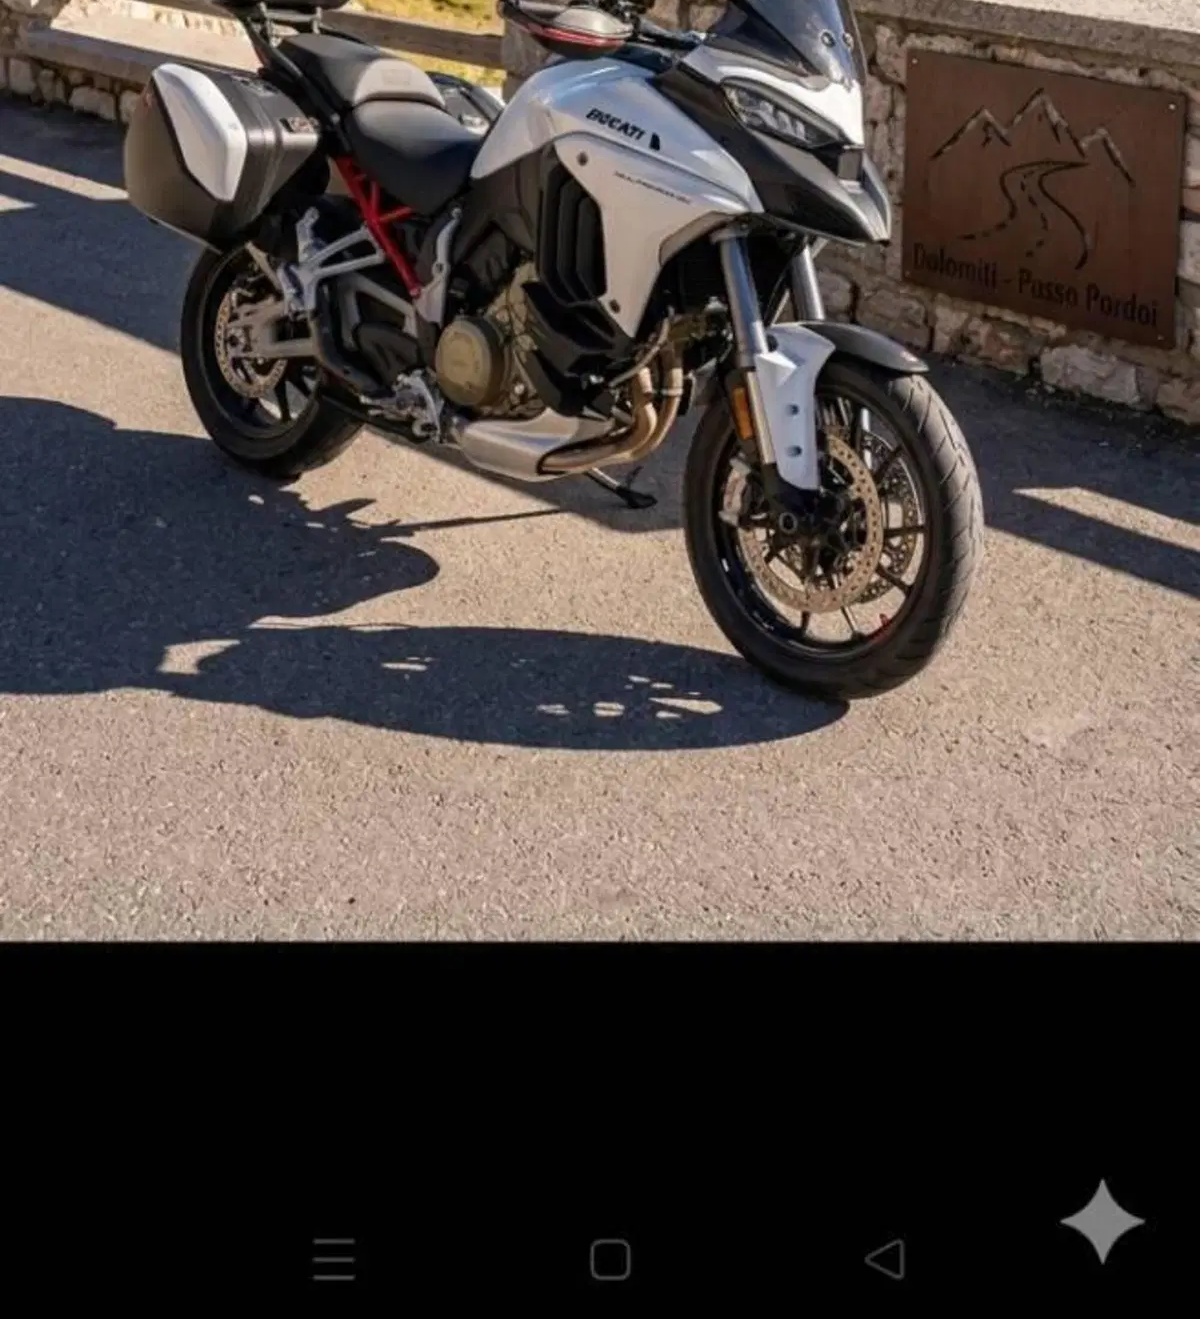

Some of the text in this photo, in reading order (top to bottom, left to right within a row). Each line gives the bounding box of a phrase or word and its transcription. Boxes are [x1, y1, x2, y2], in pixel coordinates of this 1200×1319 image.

[913, 242, 997, 290] Dolomiti
[1018, 268, 1078, 307] Passo
[1085, 282, 1160, 326] Pordoi
